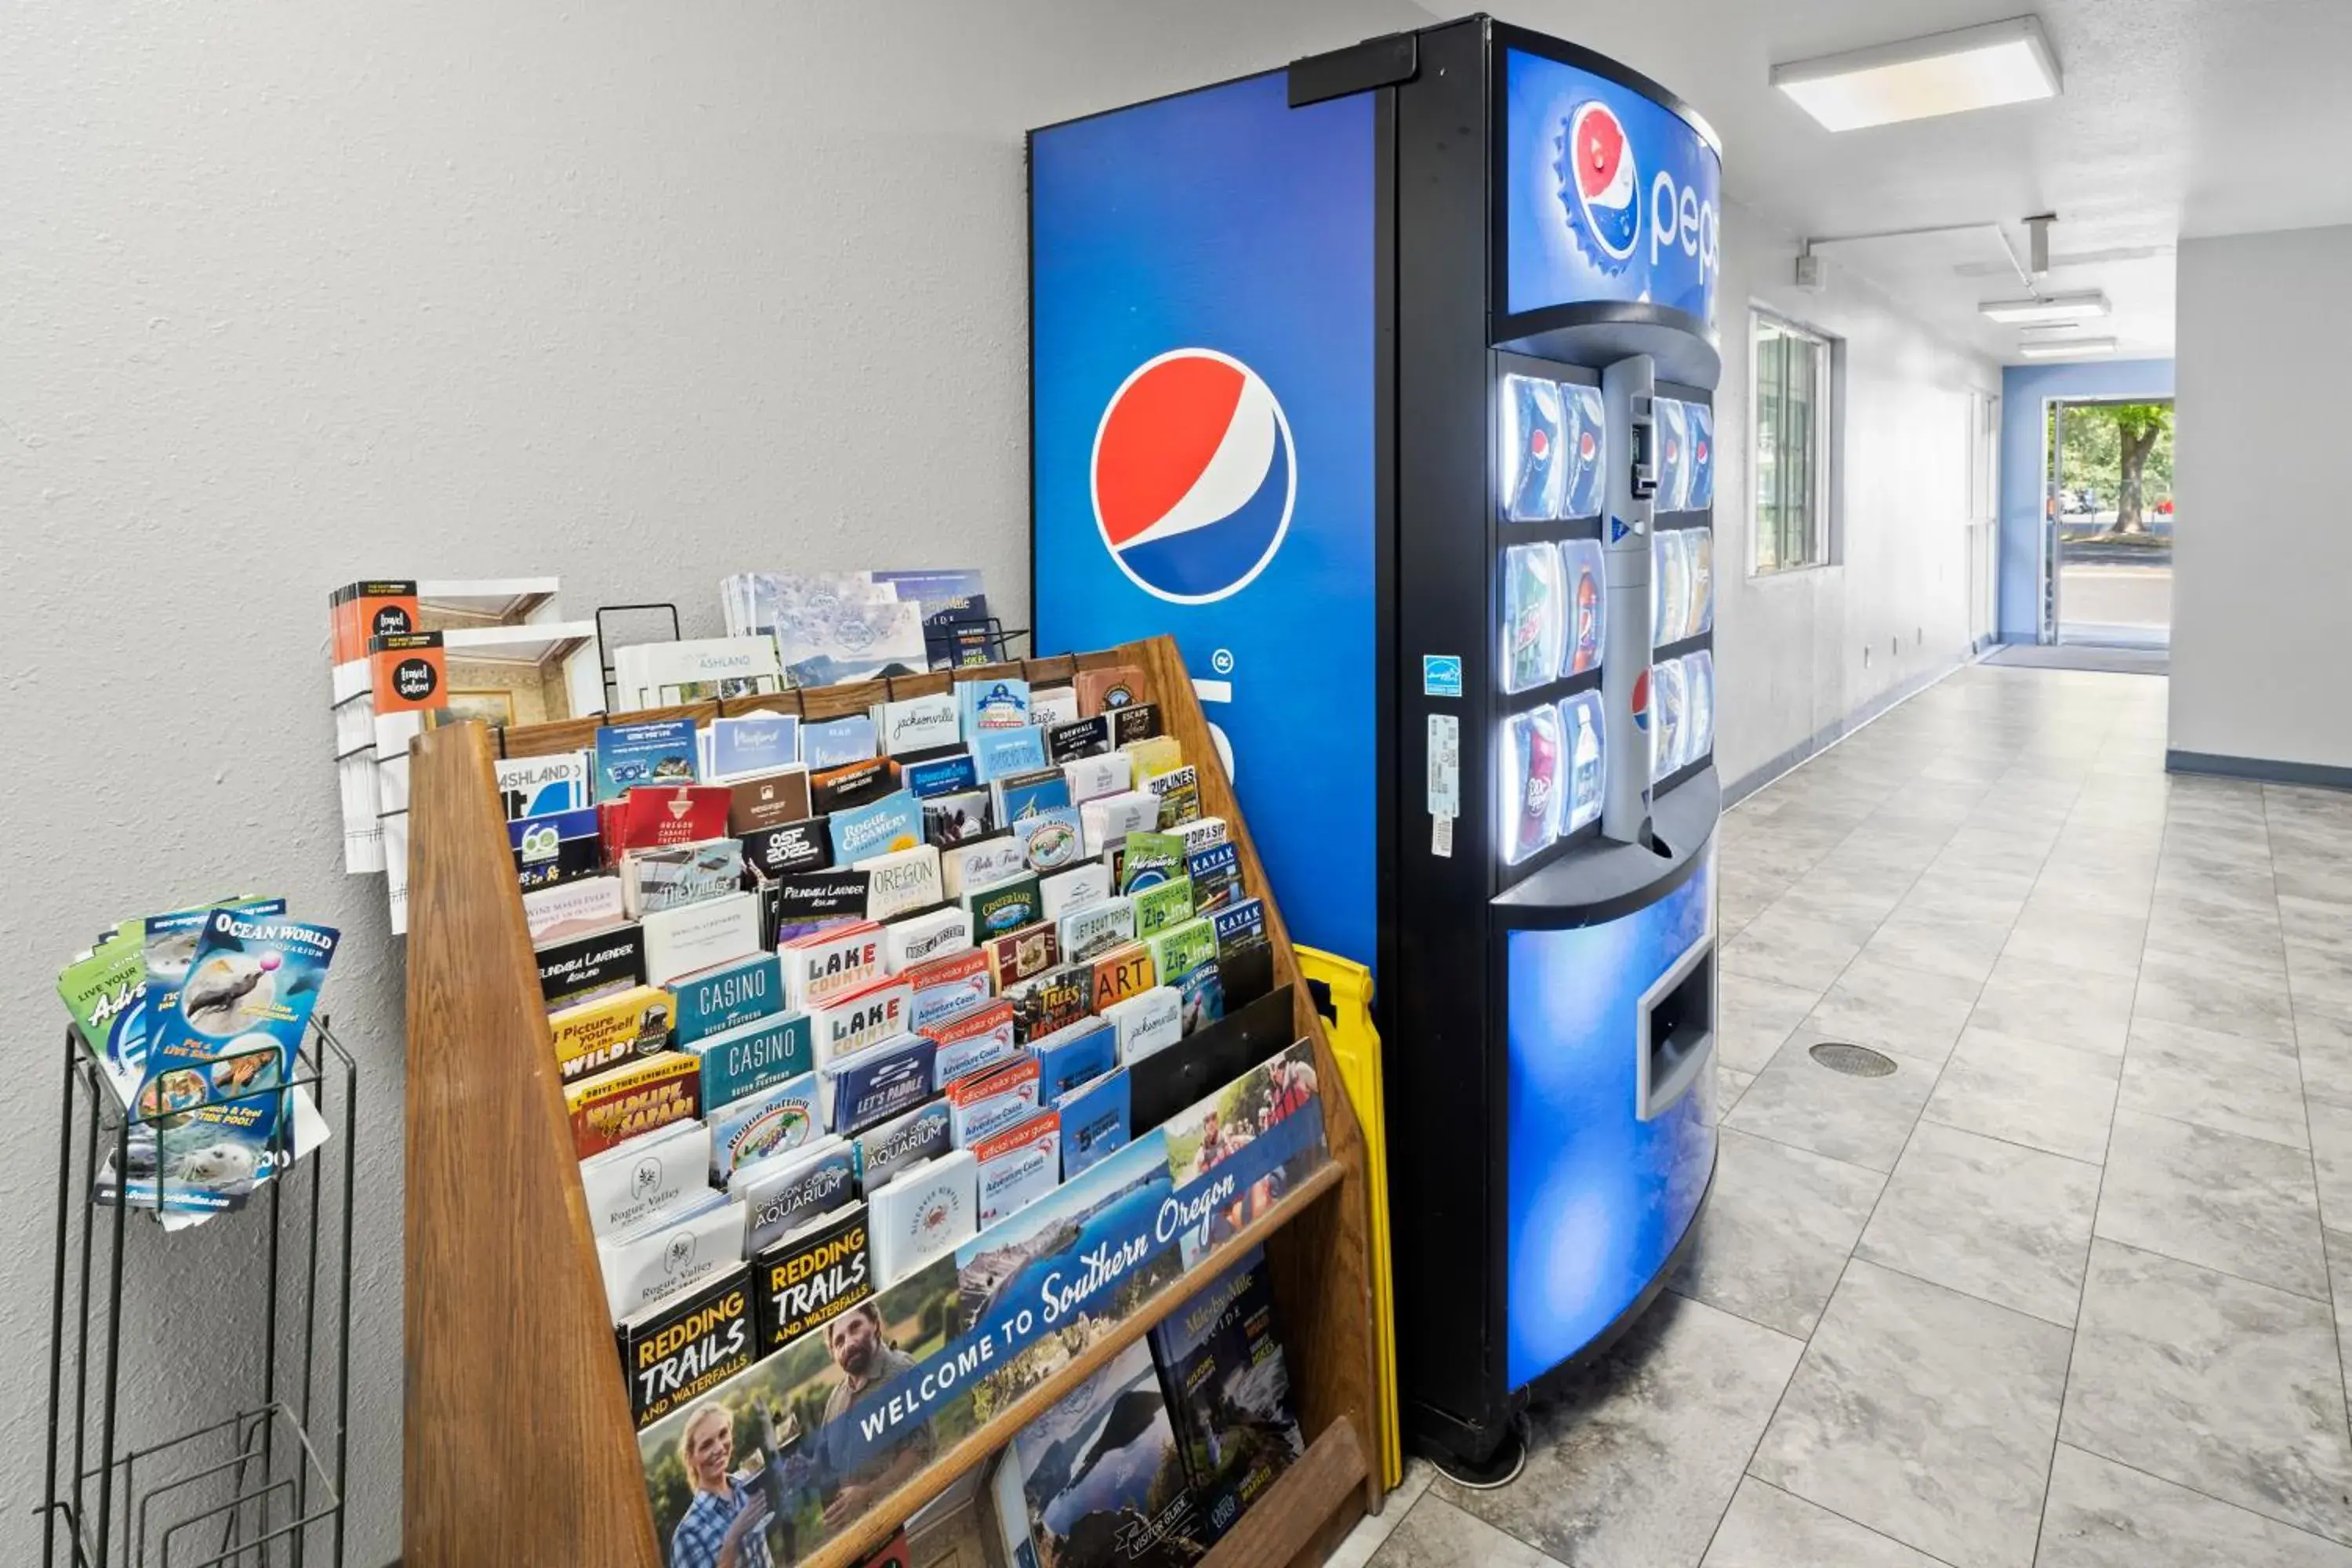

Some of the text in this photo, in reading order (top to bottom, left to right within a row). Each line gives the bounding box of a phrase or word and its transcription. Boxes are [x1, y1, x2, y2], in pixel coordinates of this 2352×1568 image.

[1650, 170, 1719, 285] pep
[401, 664, 428, 680] travel
[700, 655, 750, 668] ASHLAND
[401, 679, 429, 694] salem
[894, 707, 954, 740] jacksonville
[500, 764, 570, 788] ASHLAND
[1150, 768, 1194, 795] ZIPLINES
[842, 813, 907, 851] CREAMERY
[844, 811, 888, 838] ROGUE
[766, 840, 812, 864] 2022
[1192, 846, 1234, 873] KAYAK
[873, 859, 935, 895] OREGON
[216, 913, 278, 941] OCEAN
[280, 925, 332, 949] WORLD
[1218, 905, 1261, 933] KAYAK
[539, 942, 634, 979] ELINDABA LAVENDER
[809, 942, 877, 981] LAKE
[78, 966, 137, 1002] LIVE YOUR
[700, 968, 766, 1016] CASINO
[808, 964, 876, 995] COUNTY
[1097, 957, 1145, 1004] ART
[833, 996, 901, 1041] LAKE
[917, 993, 977, 1019] Adventure Coast
[563, 1014, 615, 1040] Picture
[579, 1014, 635, 1047] yourself
[832, 1018, 900, 1056] COUNTY
[562, 1038, 635, 1078] WILD!
[729, 1028, 795, 1076] CASINO
[942, 1046, 1000, 1076] Adventure Coast
[856, 1076, 924, 1114] LET'S PADDLE
[199, 1112, 256, 1127] TIDE POOL!
[965, 1102, 1023, 1136] Adventure Coast
[867, 1124, 942, 1171] AQUARIUM
[985, 1158, 1044, 1192] Adventure Coast
[610, 1203, 646, 1225] Rogue
[648, 1188, 680, 1207] Valley
[754, 1175, 840, 1230] AQUARIUM
[771, 1227, 866, 1293] REDDING
[642, 1262, 713, 1299] Rogue Valley
[771, 1252, 866, 1326] TRAILS
[774, 1283, 869, 1343] AND WATERFALLS
[859, 1172, 1236, 1443] WELCOME TO Southern Oregon
[638, 1290, 745, 1369] REDDING
[639, 1318, 746, 1405] TRAILS
[640, 1355, 748, 1425] AND WATERFALLS
[1132, 1519, 1164, 1552] VISITOR
